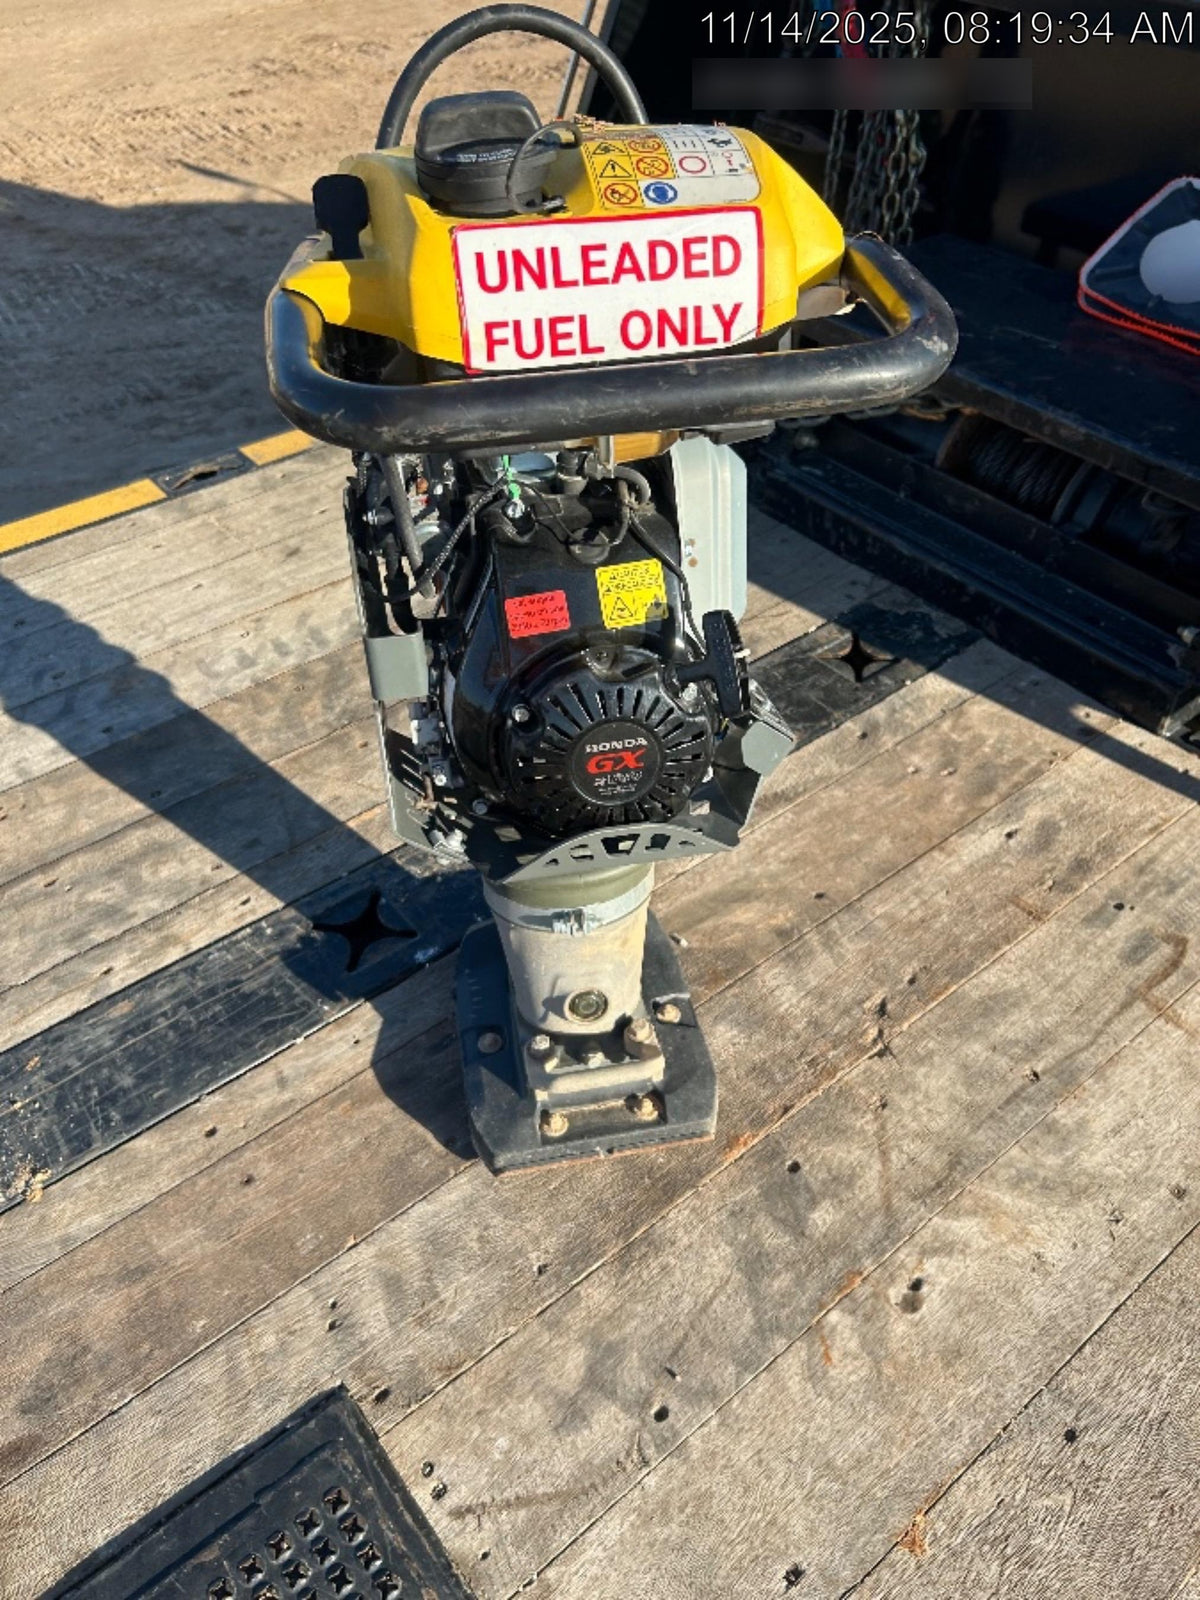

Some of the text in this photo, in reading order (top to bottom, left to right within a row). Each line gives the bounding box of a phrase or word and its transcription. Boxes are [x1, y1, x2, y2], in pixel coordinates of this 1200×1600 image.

[474, 234, 742, 295] UNLEADED
[483, 302, 744, 363] FUEL ONLY
[585, 737, 648, 753] HONDA
[585, 748, 647, 775] GX
